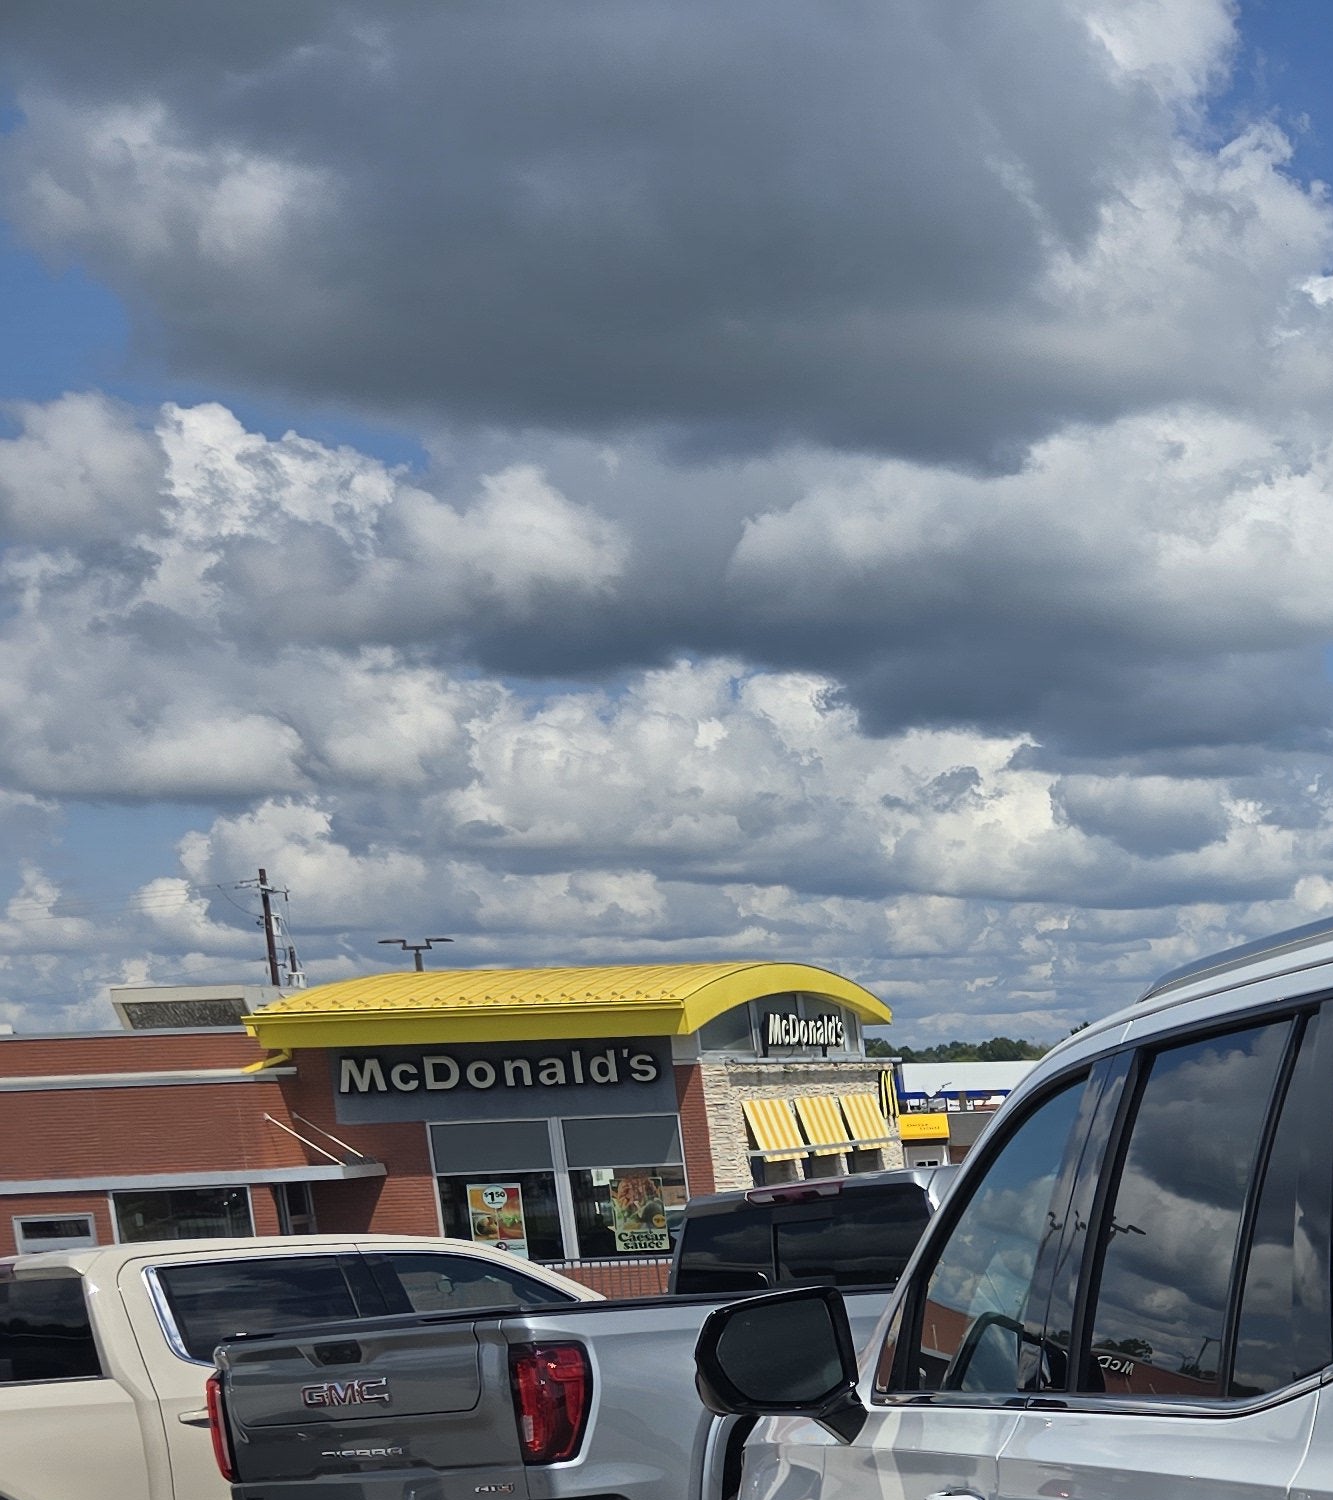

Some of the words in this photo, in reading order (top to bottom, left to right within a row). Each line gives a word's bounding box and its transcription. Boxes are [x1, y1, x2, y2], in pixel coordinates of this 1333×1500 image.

[768, 1013, 845, 1047] McDonald's
[339, 1048, 658, 1093] McDonald's
[623, 1241, 663, 1250] sauce
[301, 1376, 391, 1409] GMC
